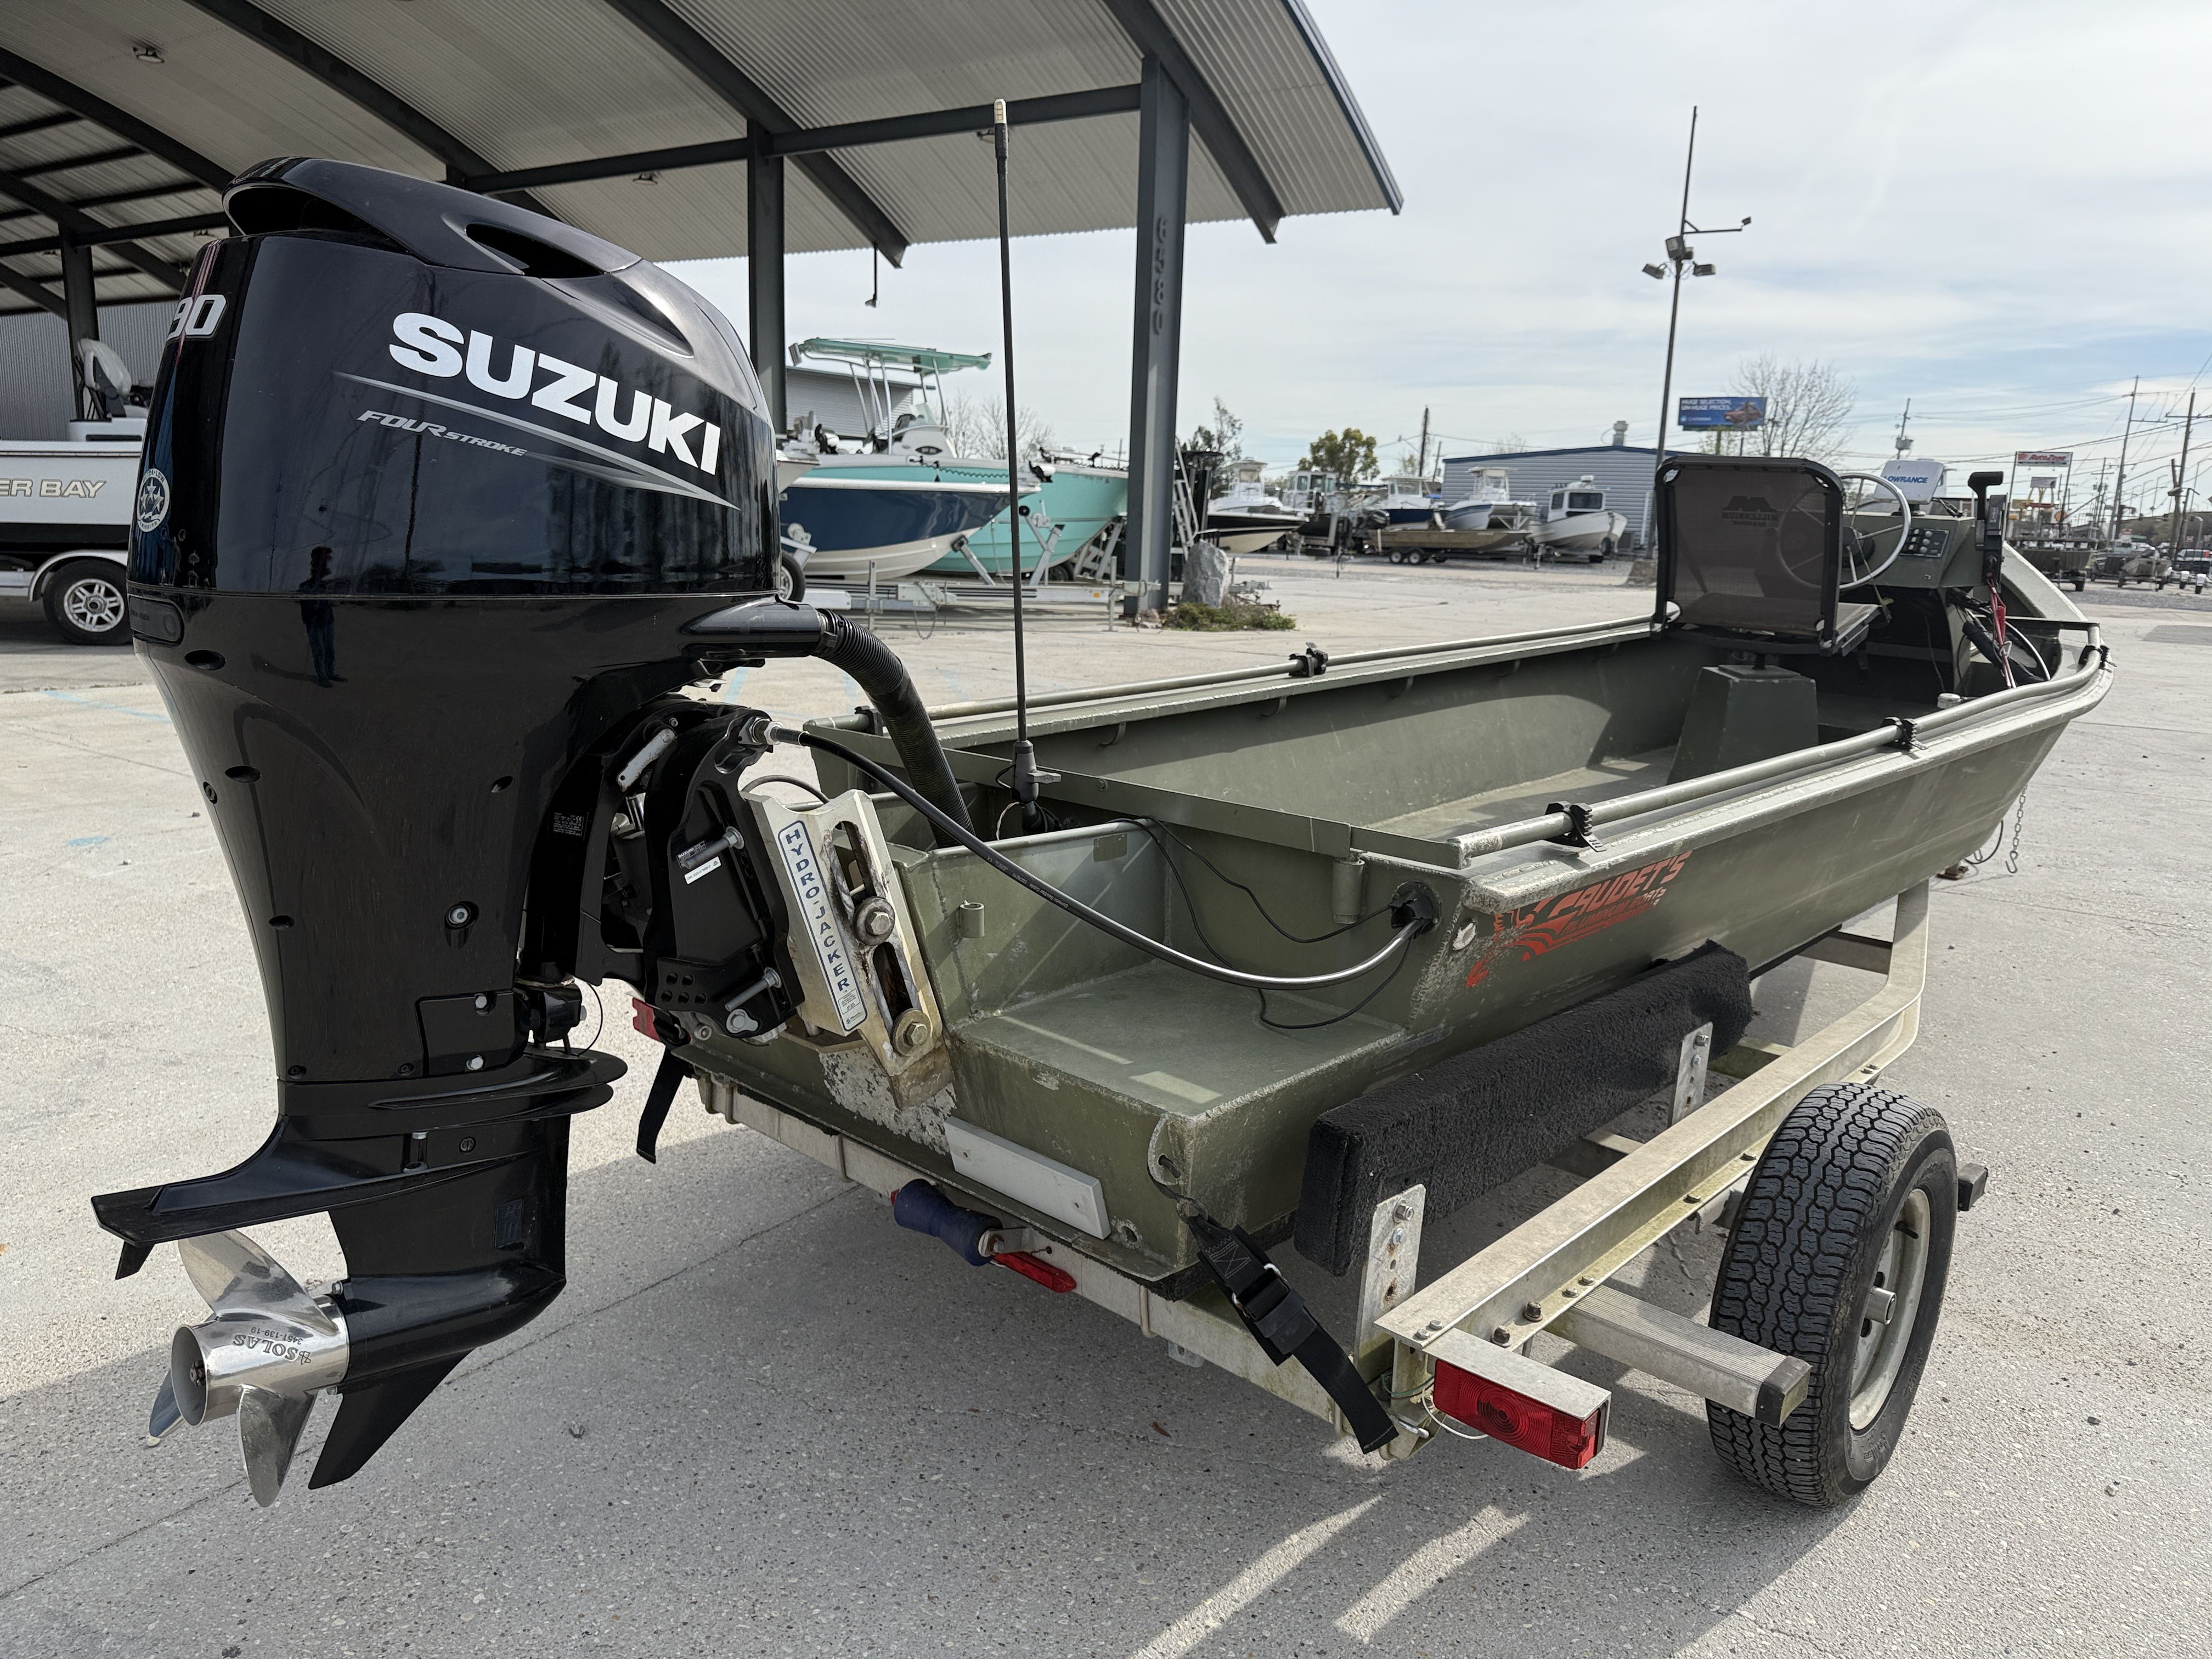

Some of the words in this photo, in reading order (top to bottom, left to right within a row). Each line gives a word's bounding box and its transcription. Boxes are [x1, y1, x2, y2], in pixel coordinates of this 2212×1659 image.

[166, 294, 227, 341] 90
[389, 312, 721, 476] SUZUKI
[357, 410, 447, 437] FOUR
[443, 431, 528, 456] STROKE
[39, 478, 107, 499] BAY
[785, 828, 850, 992] HYDRO-JACKER
[233, 1334, 298, 1361] SOLAS
[251, 1327, 303, 1345] 3451-139-19
